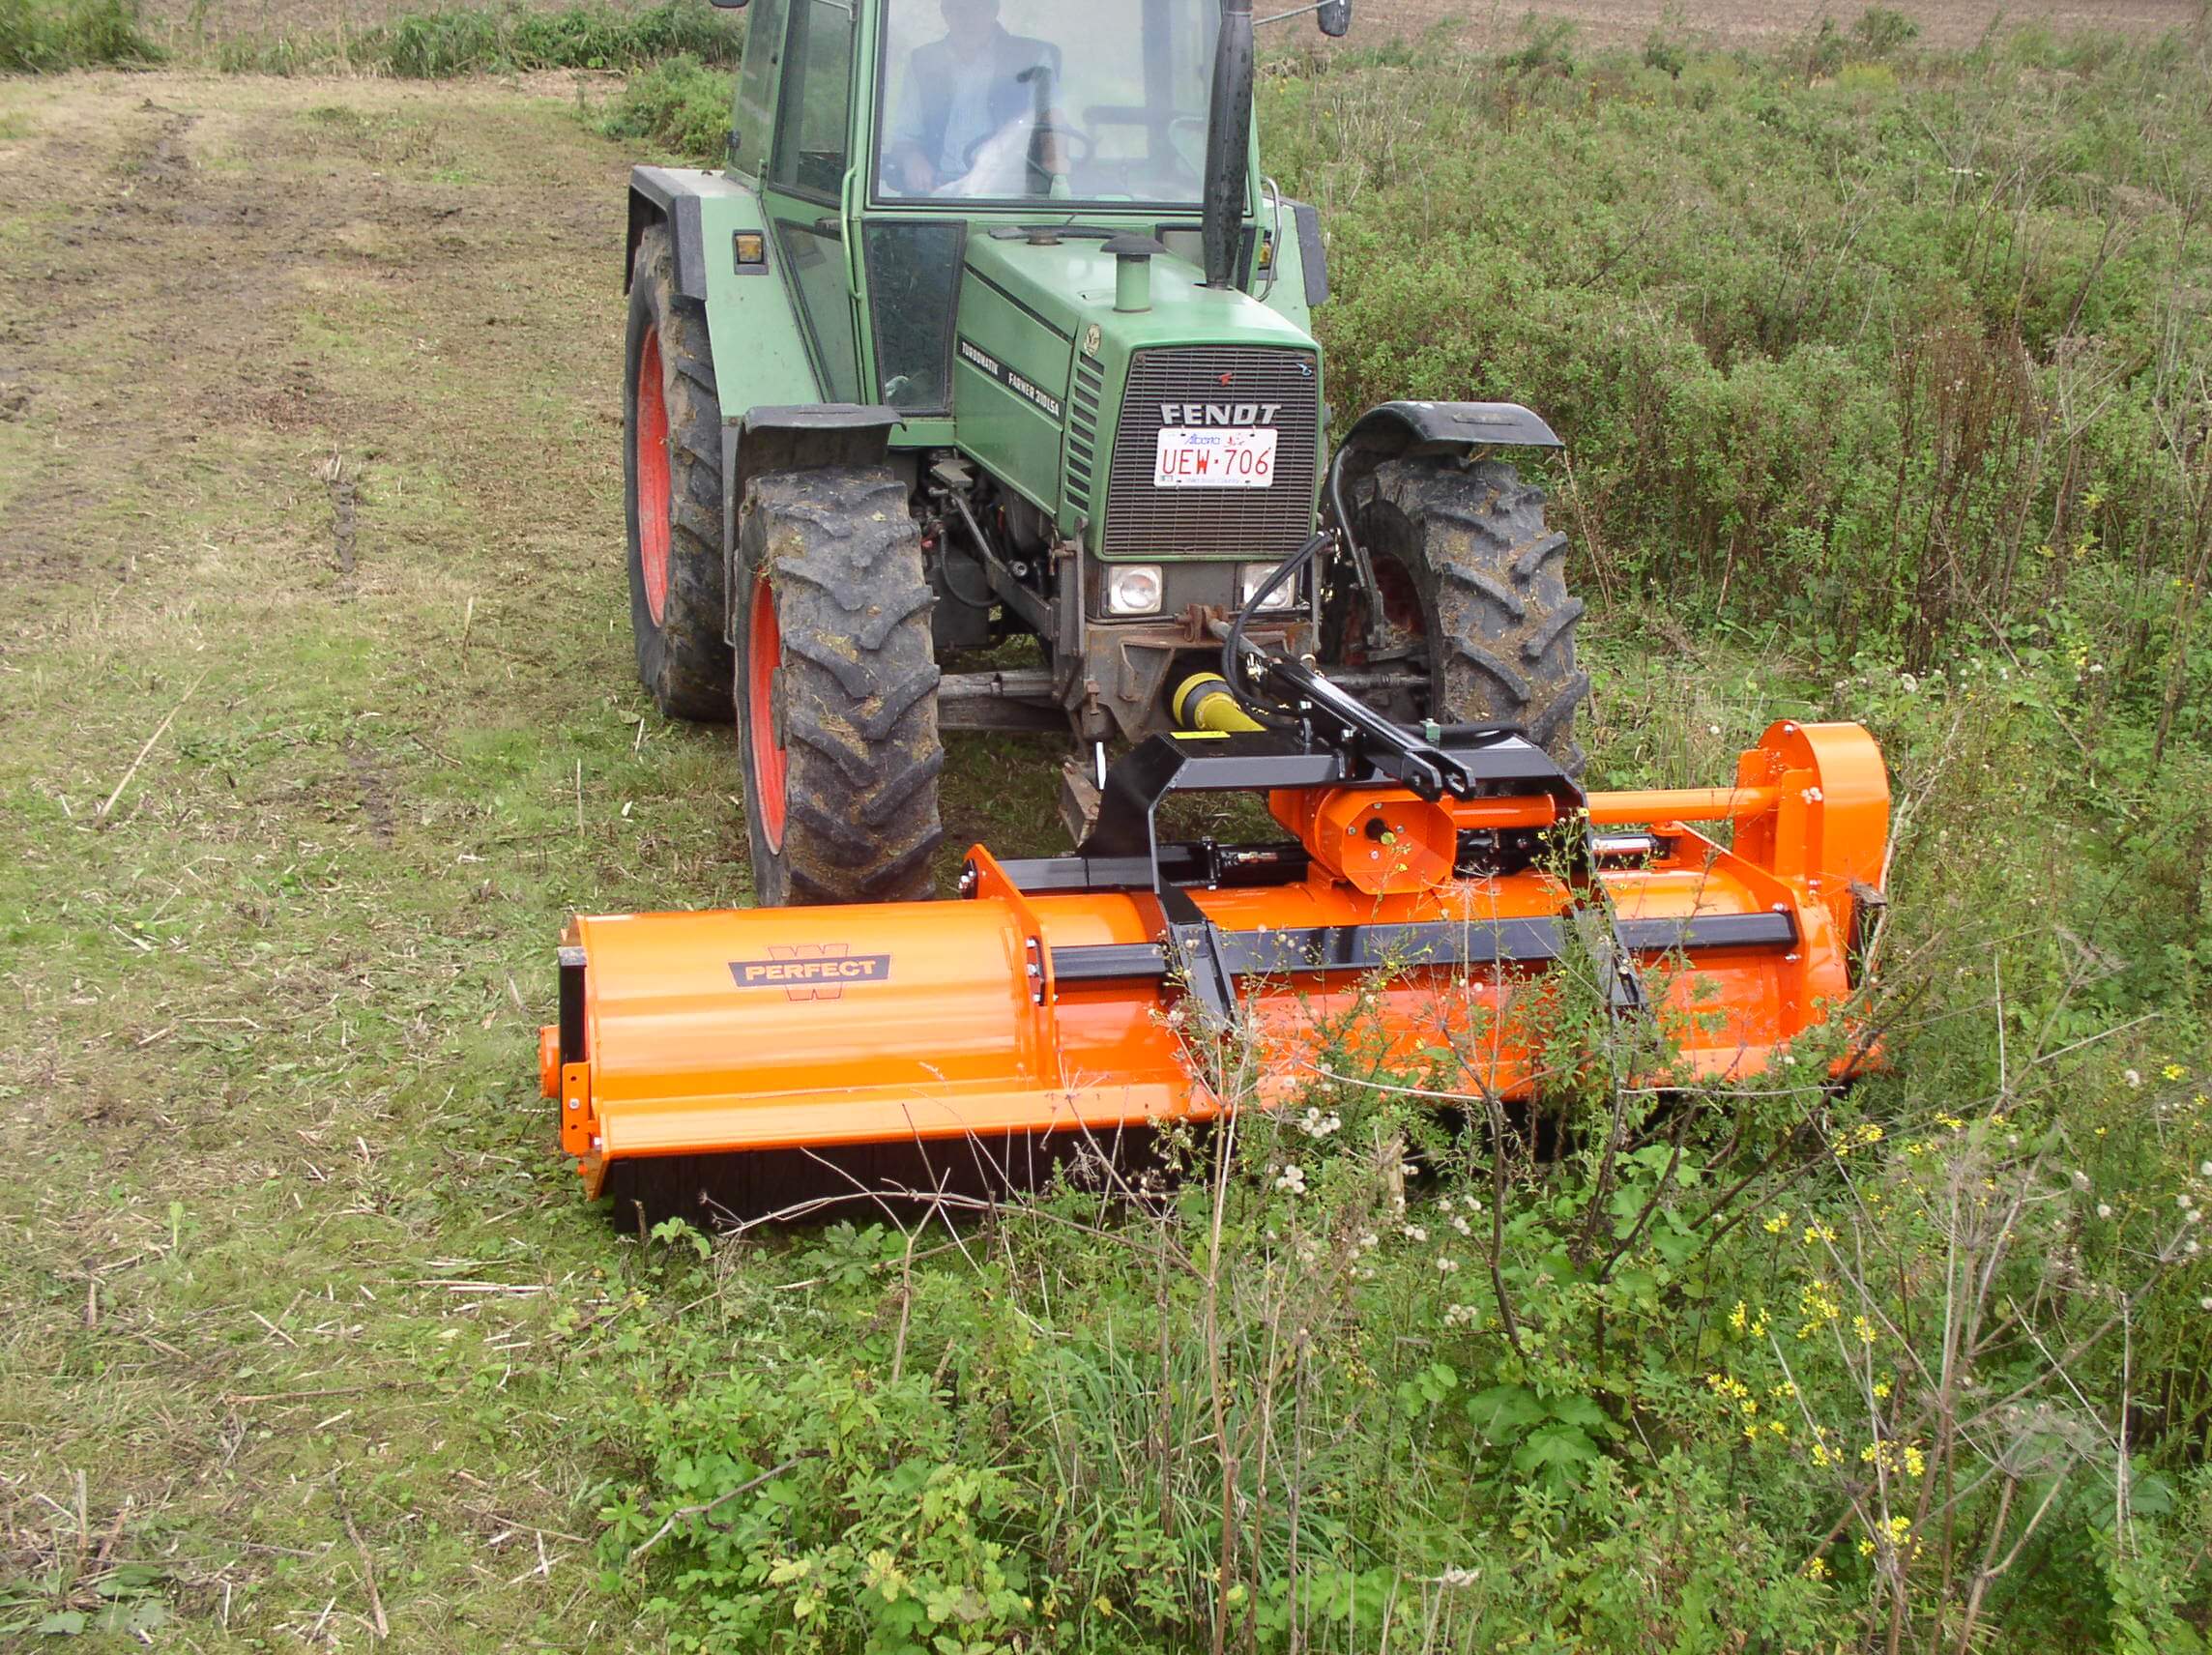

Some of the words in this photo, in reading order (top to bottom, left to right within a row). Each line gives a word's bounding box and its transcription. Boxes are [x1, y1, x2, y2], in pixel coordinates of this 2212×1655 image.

[1008, 371, 1035, 399] FARMER
[1160, 403, 1282, 425] FENDT
[744, 960, 876, 981] PERFECT
